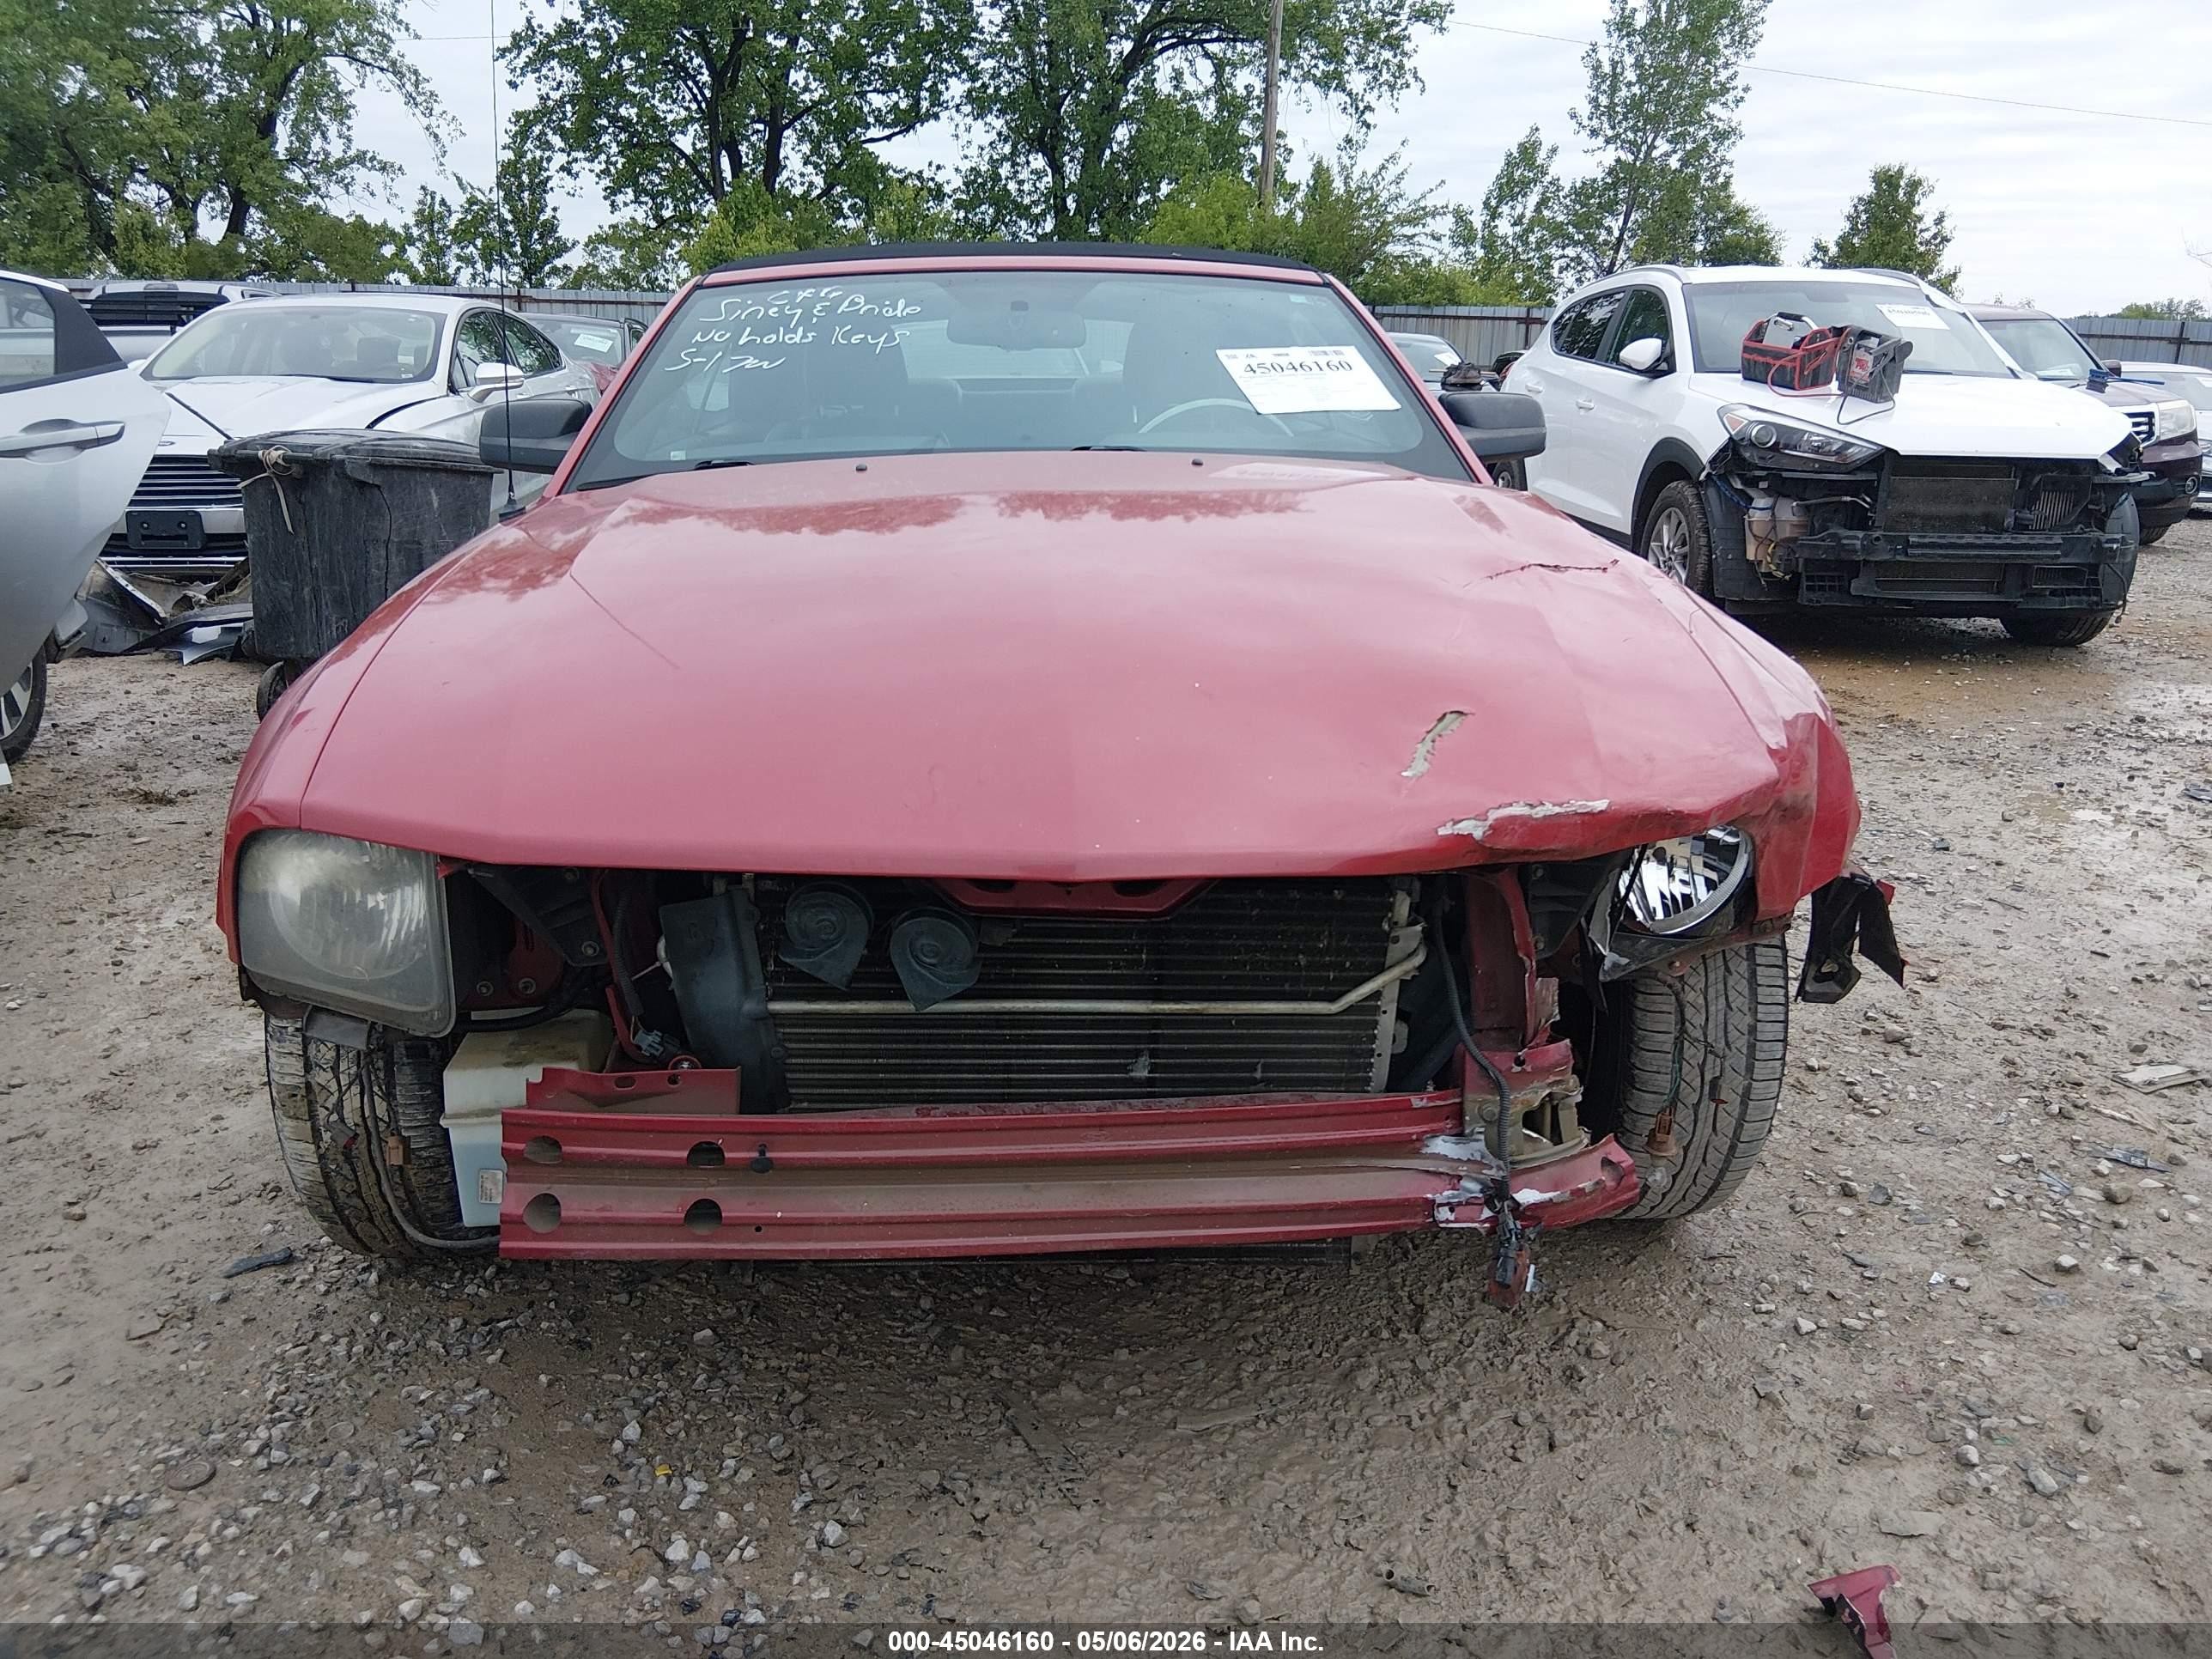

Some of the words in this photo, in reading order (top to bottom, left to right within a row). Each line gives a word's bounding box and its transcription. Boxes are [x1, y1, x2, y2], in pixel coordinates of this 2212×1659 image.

[738, 326, 817, 345] holds
[831, 325, 910, 354] Keys
[1243, 360, 1352, 374] 45046160
